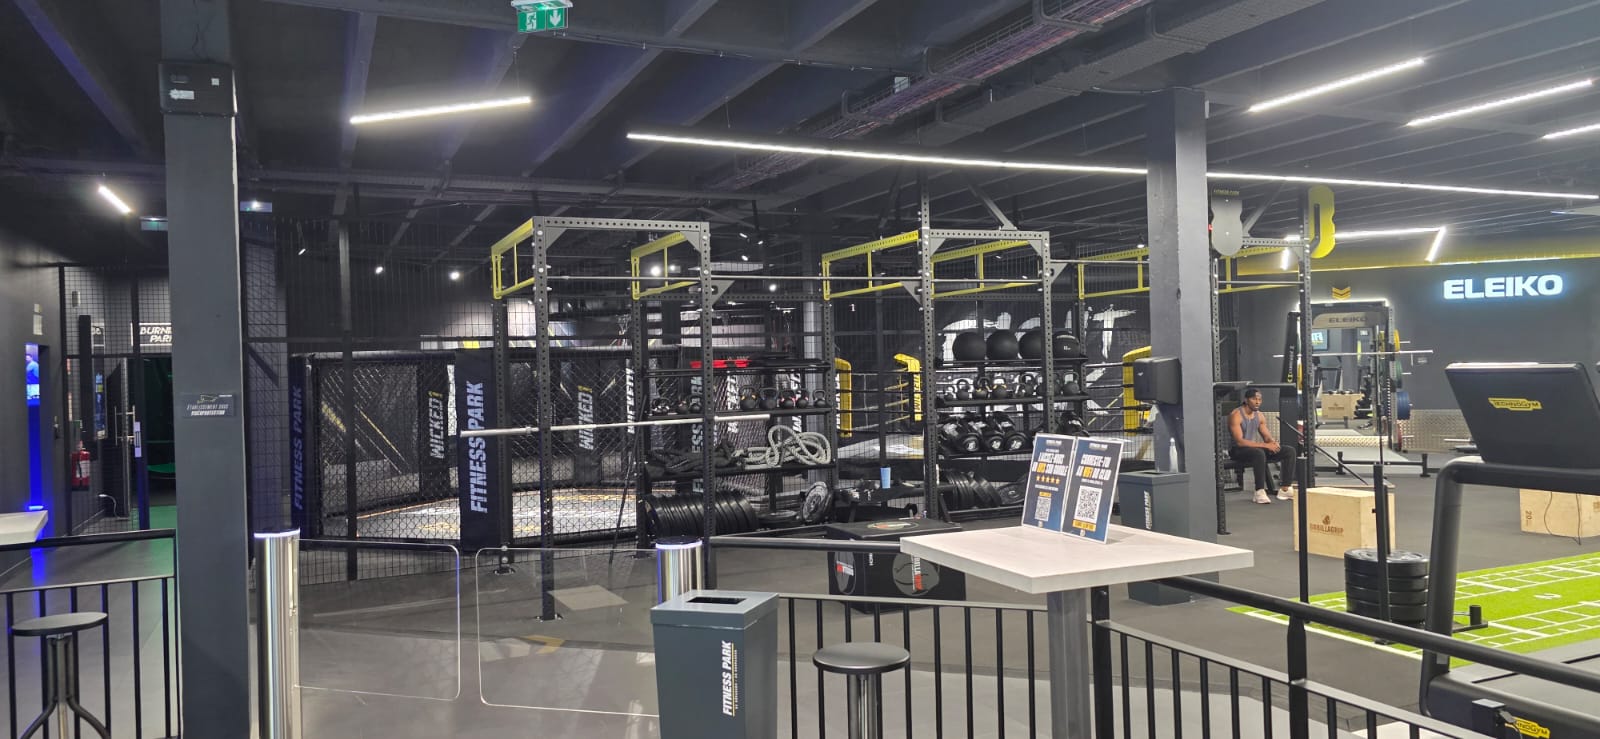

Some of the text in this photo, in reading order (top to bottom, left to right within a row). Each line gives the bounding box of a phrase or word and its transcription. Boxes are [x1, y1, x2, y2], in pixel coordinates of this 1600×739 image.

[1443, 274, 1563, 300] ELEIKO
[139, 326, 172, 335] BURNI
[292, 385, 304, 511] FITNESS PARK
[466, 379, 489, 514] FITNESS PARK
[721, 639, 733, 716] FITNESS PARK
